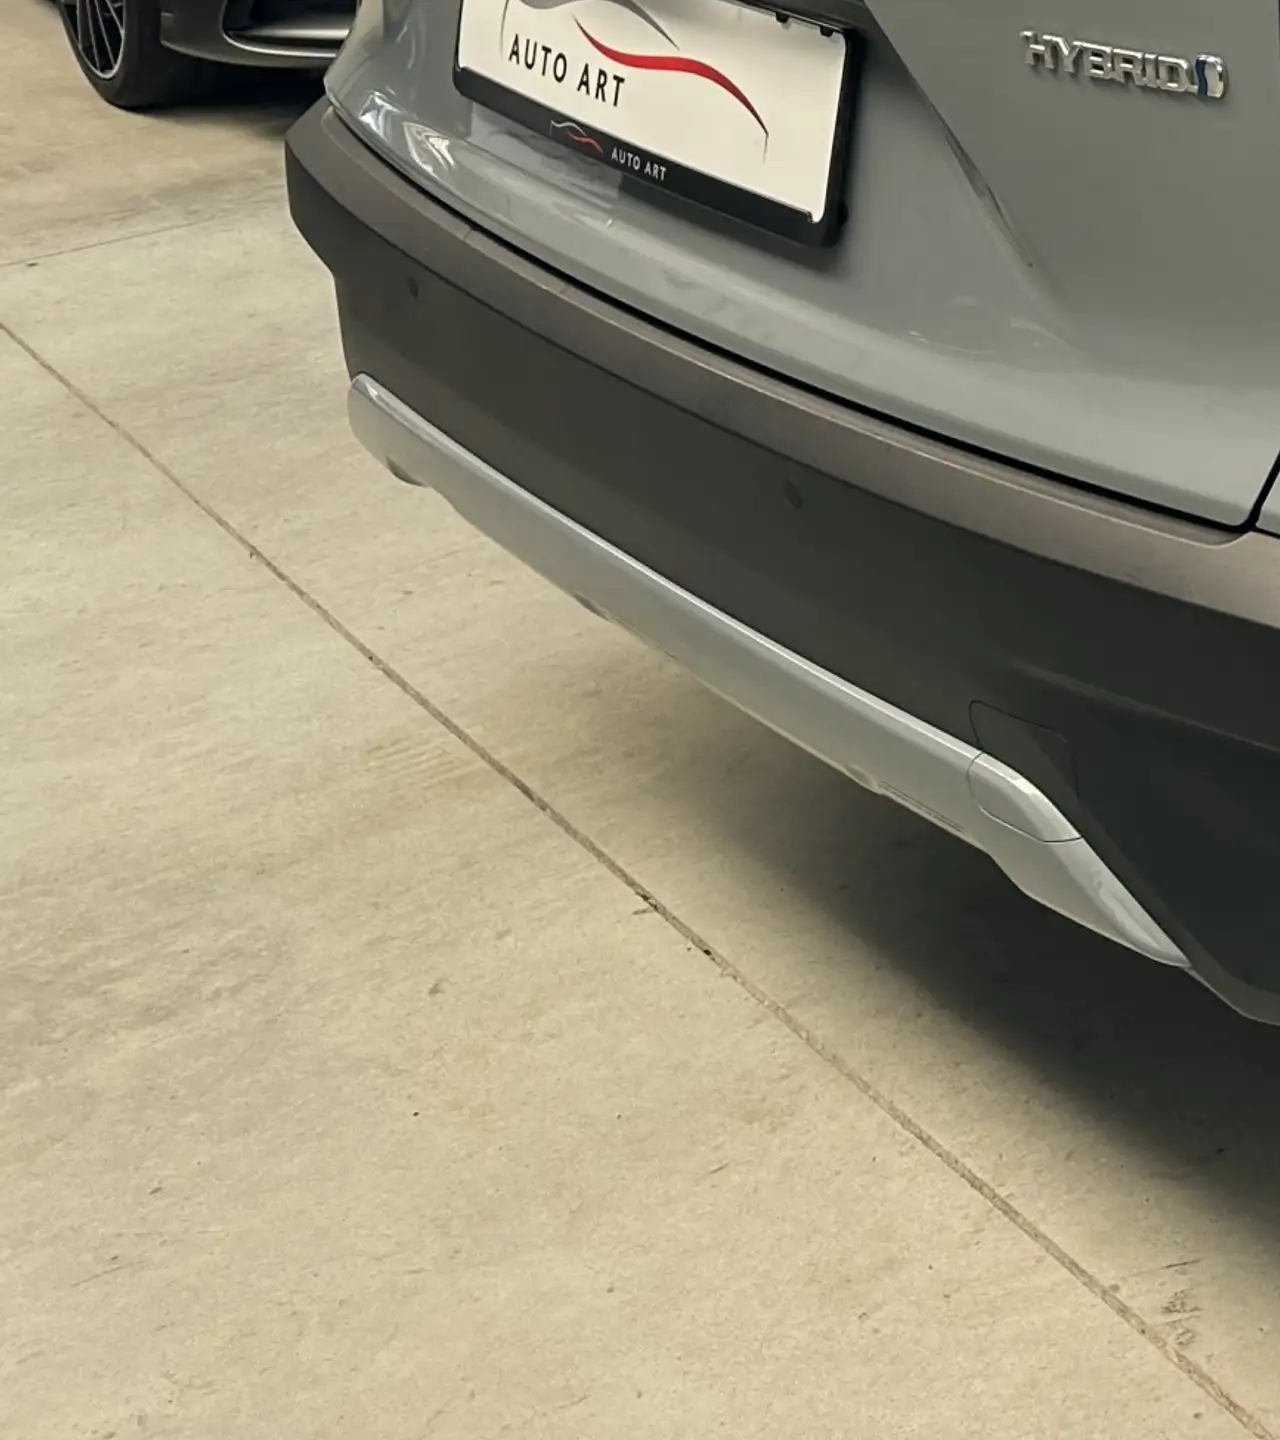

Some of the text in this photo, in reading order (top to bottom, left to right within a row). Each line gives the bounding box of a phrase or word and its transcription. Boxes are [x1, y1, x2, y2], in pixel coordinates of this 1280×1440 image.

[508, 33, 626, 107] AUTO ART
[1020, 30, 1188, 93] HYBRID
[611, 147, 667, 181] AUTO ART
